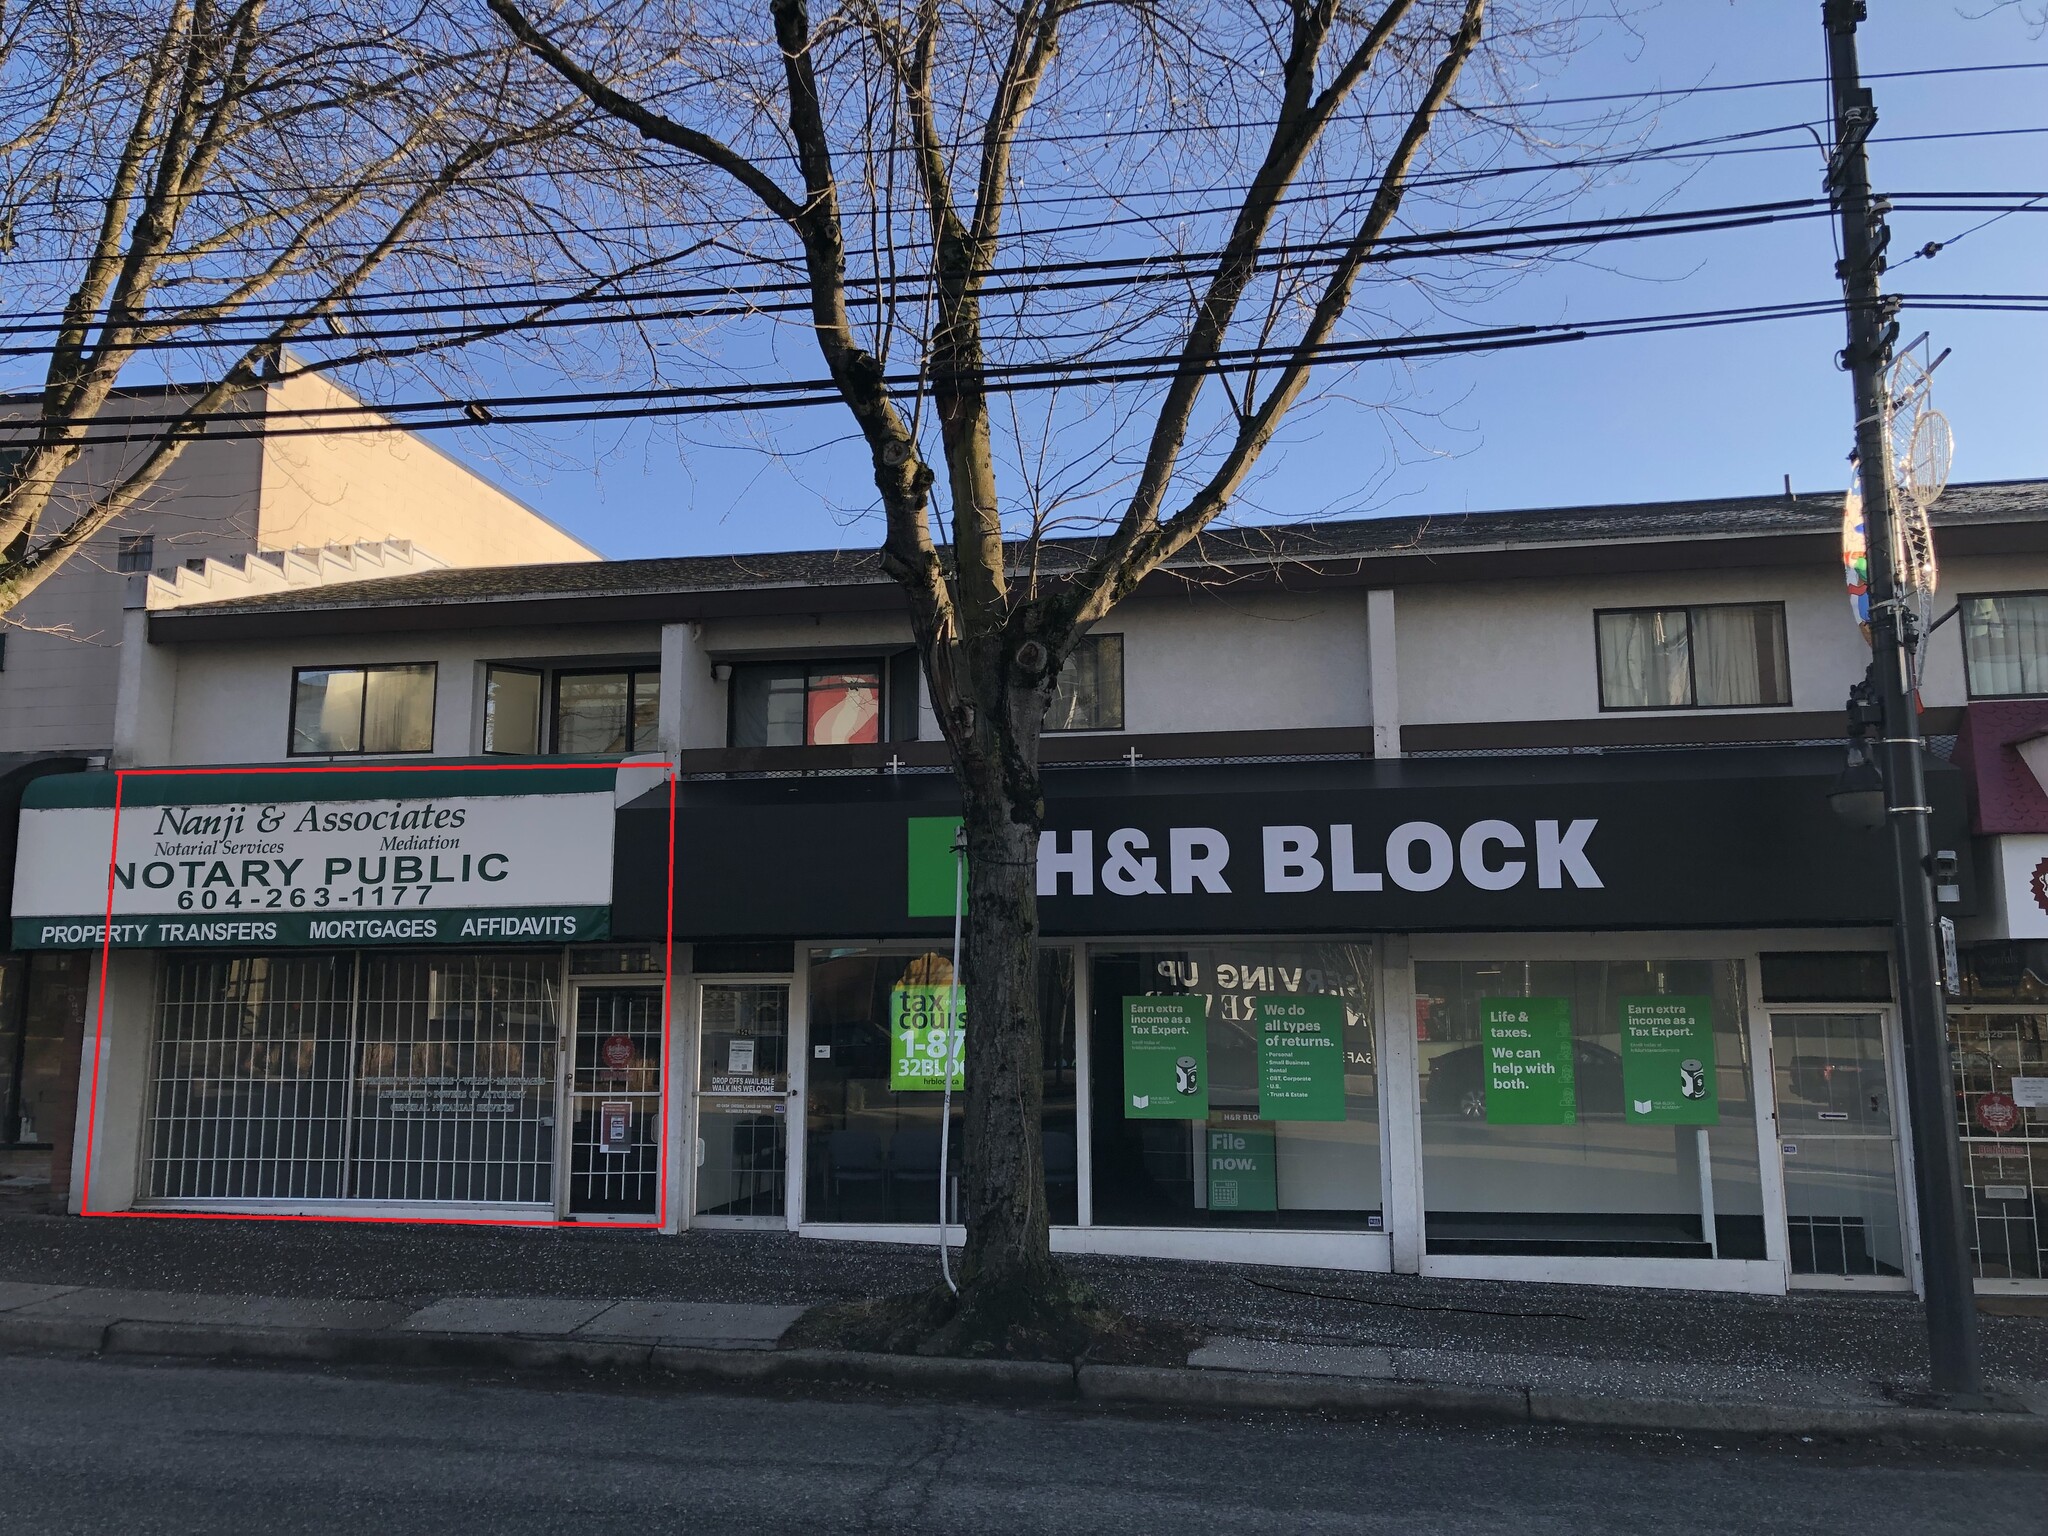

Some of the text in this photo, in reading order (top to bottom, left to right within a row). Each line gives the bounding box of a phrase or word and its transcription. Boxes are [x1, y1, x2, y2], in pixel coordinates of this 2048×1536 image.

[154, 803, 466, 843] Nanji & Associates
[154, 835, 460, 857] Notarial Services Mediation
[1035, 819, 1605, 896] H&R BLOCK
[110, 853, 510, 890] NOTARY PUBLIC
[177, 885, 433, 910] 604-263-1177
[40, 916, 576, 944] PROPERTY TRANSFERS MORTGAGES AFFIDAVITS
[900, 991, 944, 1012] tax
[1131, 1004, 1183, 1014] Earn extra
[1264, 1004, 1285, 1015] We
[1288, 1004, 1305, 1016] do
[1628, 1005, 1686, 1014] Earn extra
[899, 1012, 967, 1029] cours
[1131, 1015, 1169, 1024] income
[1171, 1016, 1183, 1024] as
[1490, 1011, 1529, 1022] Life &
[1628, 1016, 1671, 1025] income
[1673, 1017, 1686, 1025] as
[1131, 1025, 1189, 1036] Tax Expert.
[1265, 1020, 1321, 1033] all types
[1491, 1028, 1531, 1038] taxes.
[1629, 1027, 1694, 1038] Tax Expert.
[899, 1030, 965, 1058] 1-87
[1265, 1035, 1334, 1047] of returns.
[1492, 1047, 1541, 1058] We can
[898, 1059, 964, 1077] 32BLO
[1493, 1062, 1555, 1076] help with
[1493, 1078, 1529, 1089] both.
[1212, 1133, 1246, 1150] File
[1212, 1157, 1256, 1171] now.
